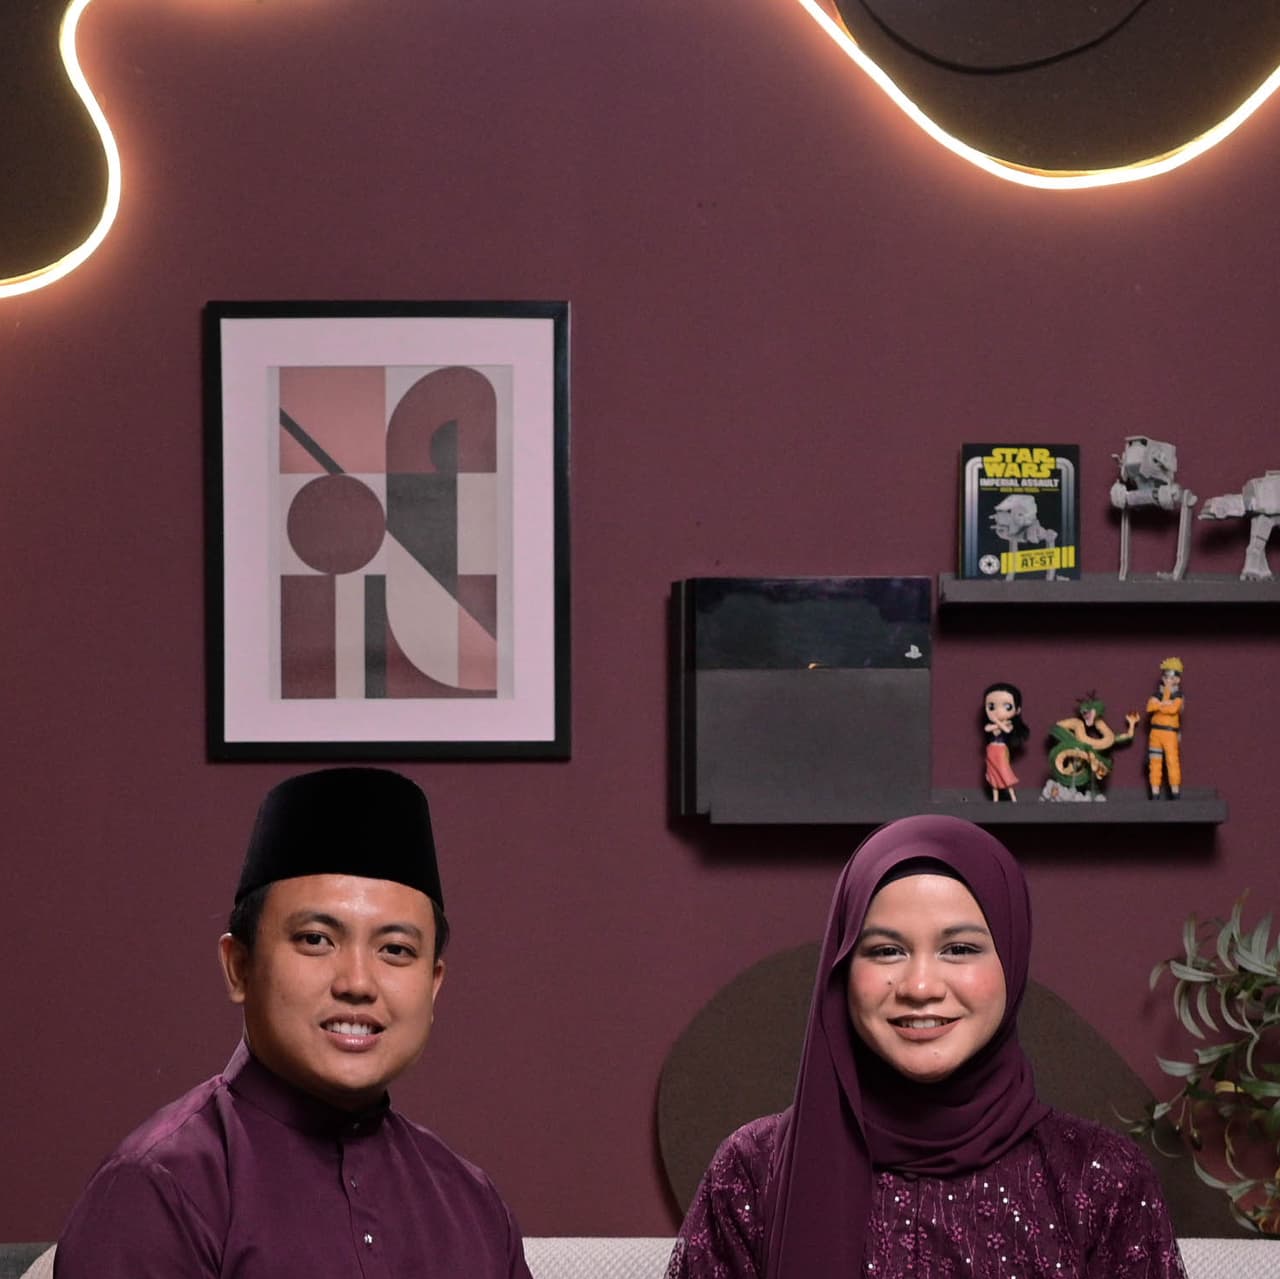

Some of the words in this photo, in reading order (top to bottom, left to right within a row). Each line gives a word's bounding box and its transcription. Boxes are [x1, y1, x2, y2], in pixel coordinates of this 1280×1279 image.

[983, 448, 1051, 463] STAR
[983, 457, 1056, 479] WARS
[980, 478, 1019, 488] IMPERIAL
[1021, 478, 1059, 488] ASSAULT
[1021, 555, 1054, 569] AT-ST
